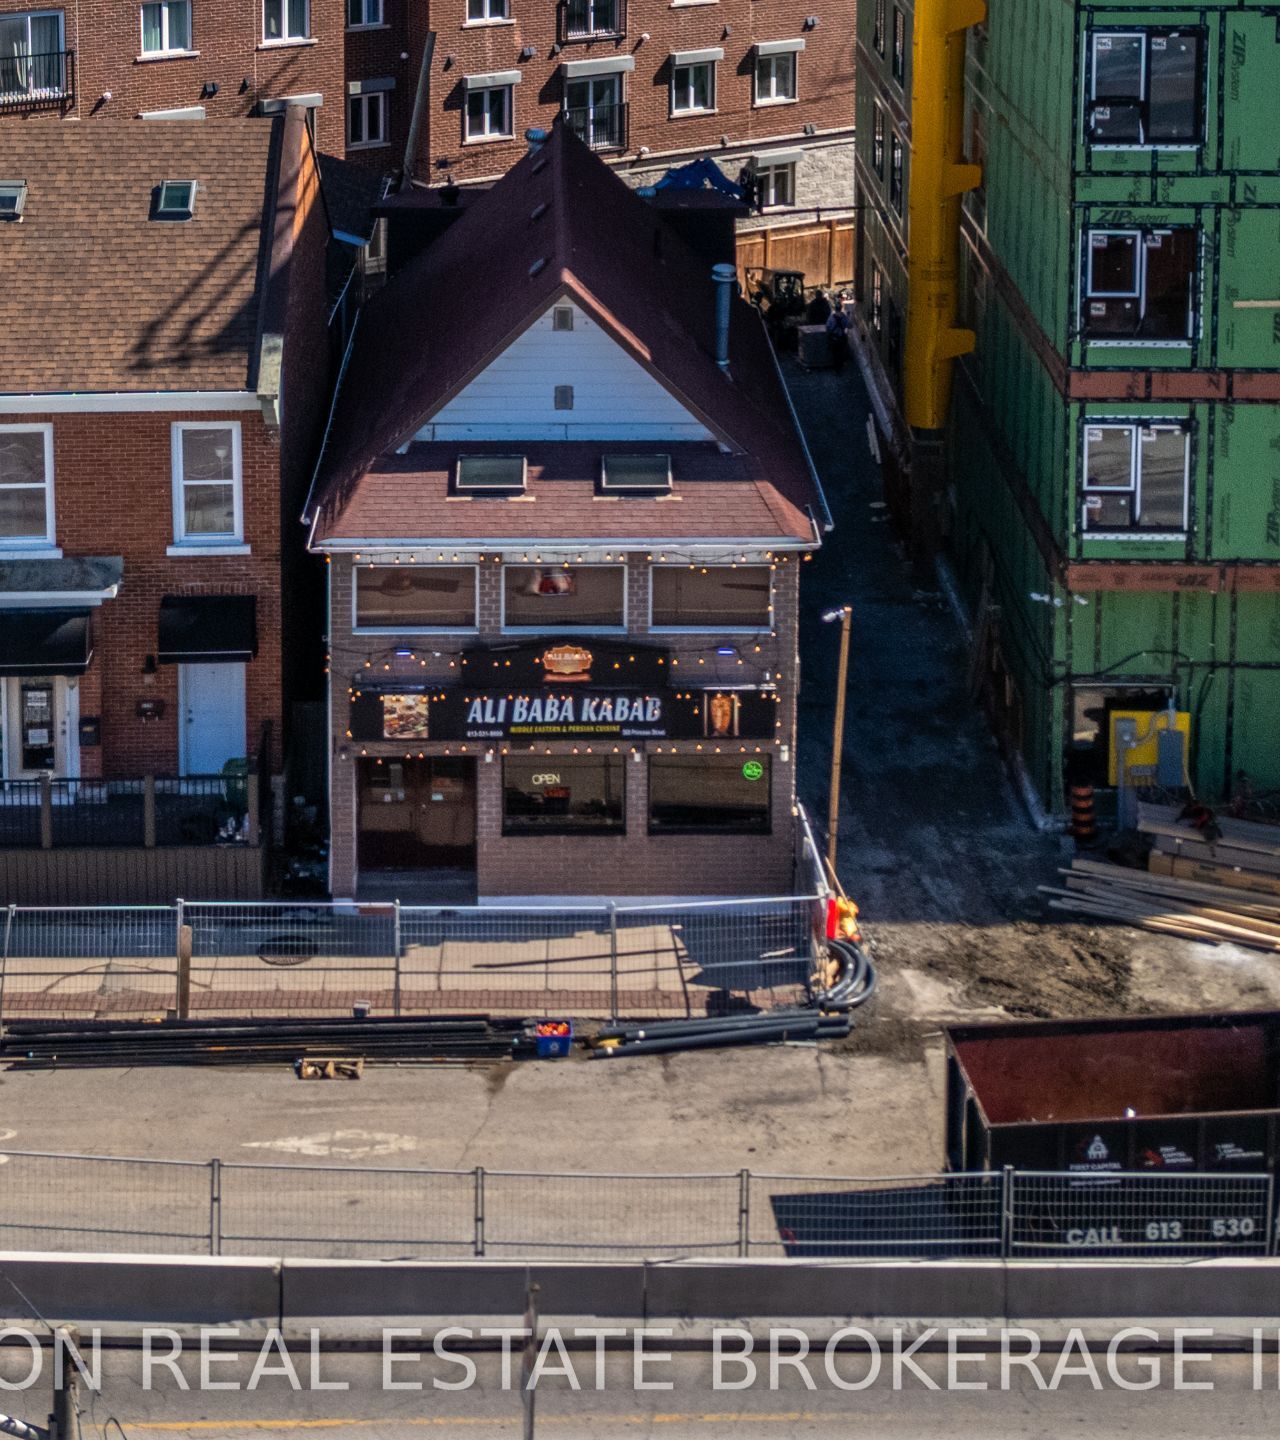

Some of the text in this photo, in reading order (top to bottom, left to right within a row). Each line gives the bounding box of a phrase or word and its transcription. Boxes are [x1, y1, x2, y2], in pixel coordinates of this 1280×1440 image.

[467, 696, 662, 724] ALI BABA KABAB
[532, 773, 561, 785] OPEN
[1066, 1226, 1122, 1245] CALL
[1145, 1222, 1182, 1240] 613
[1212, 1218, 1254, 1237] 530
